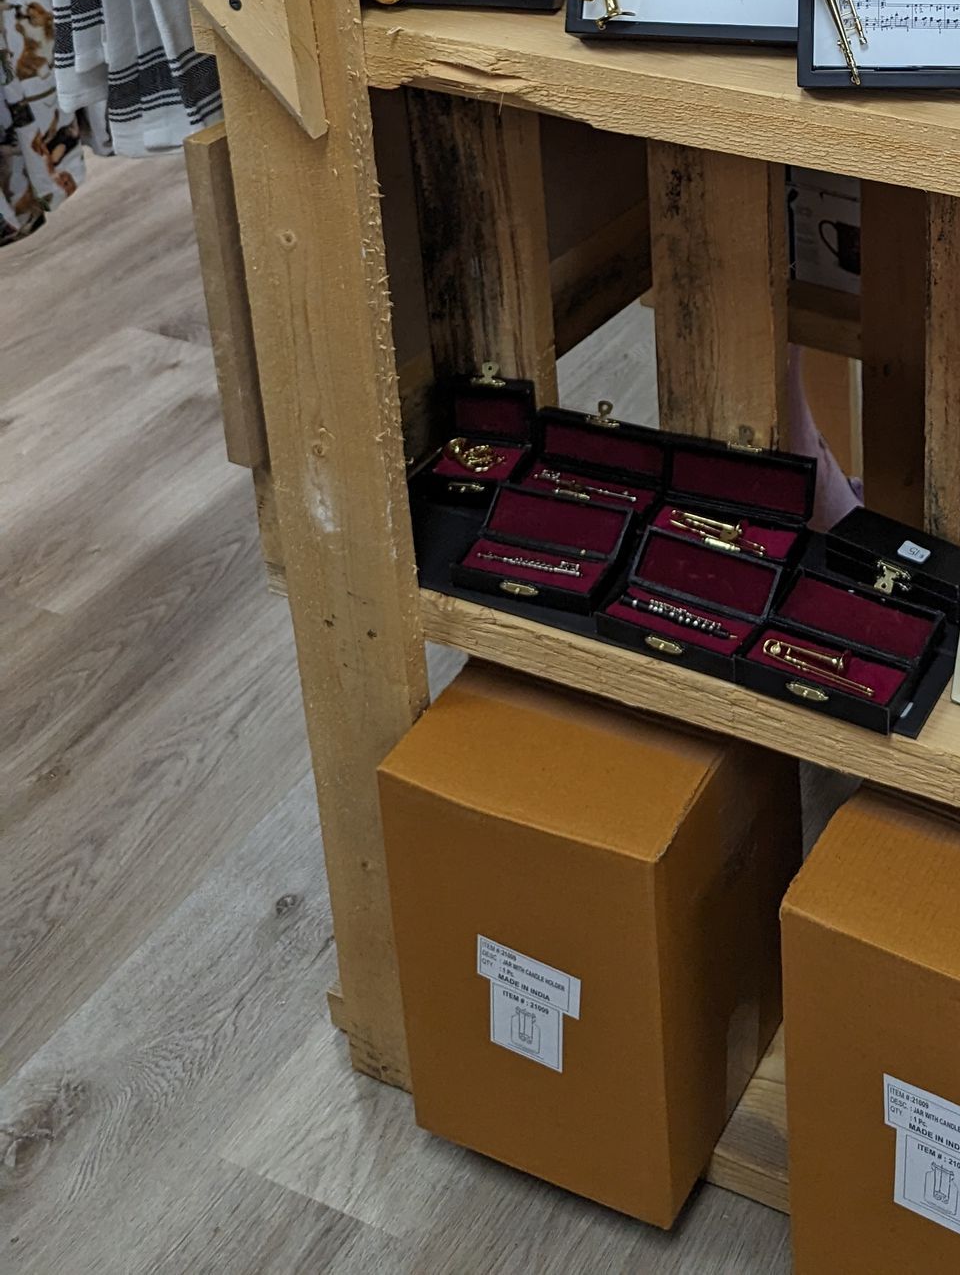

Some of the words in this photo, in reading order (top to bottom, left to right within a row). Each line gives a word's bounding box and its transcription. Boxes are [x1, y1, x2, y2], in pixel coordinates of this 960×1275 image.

[498, 972, 520, 988] MADE
[530, 987, 550, 1002] INDIA
[503, 990, 519, 1002] ITEM
[889, 1086, 905, 1099] ITEM
[889, 1105, 903, 1116] QTY
[908, 1122, 933, 1139] MADE
[939, 1117, 960, 1133] CANDLE
[917, 1143, 936, 1157] ITEM
